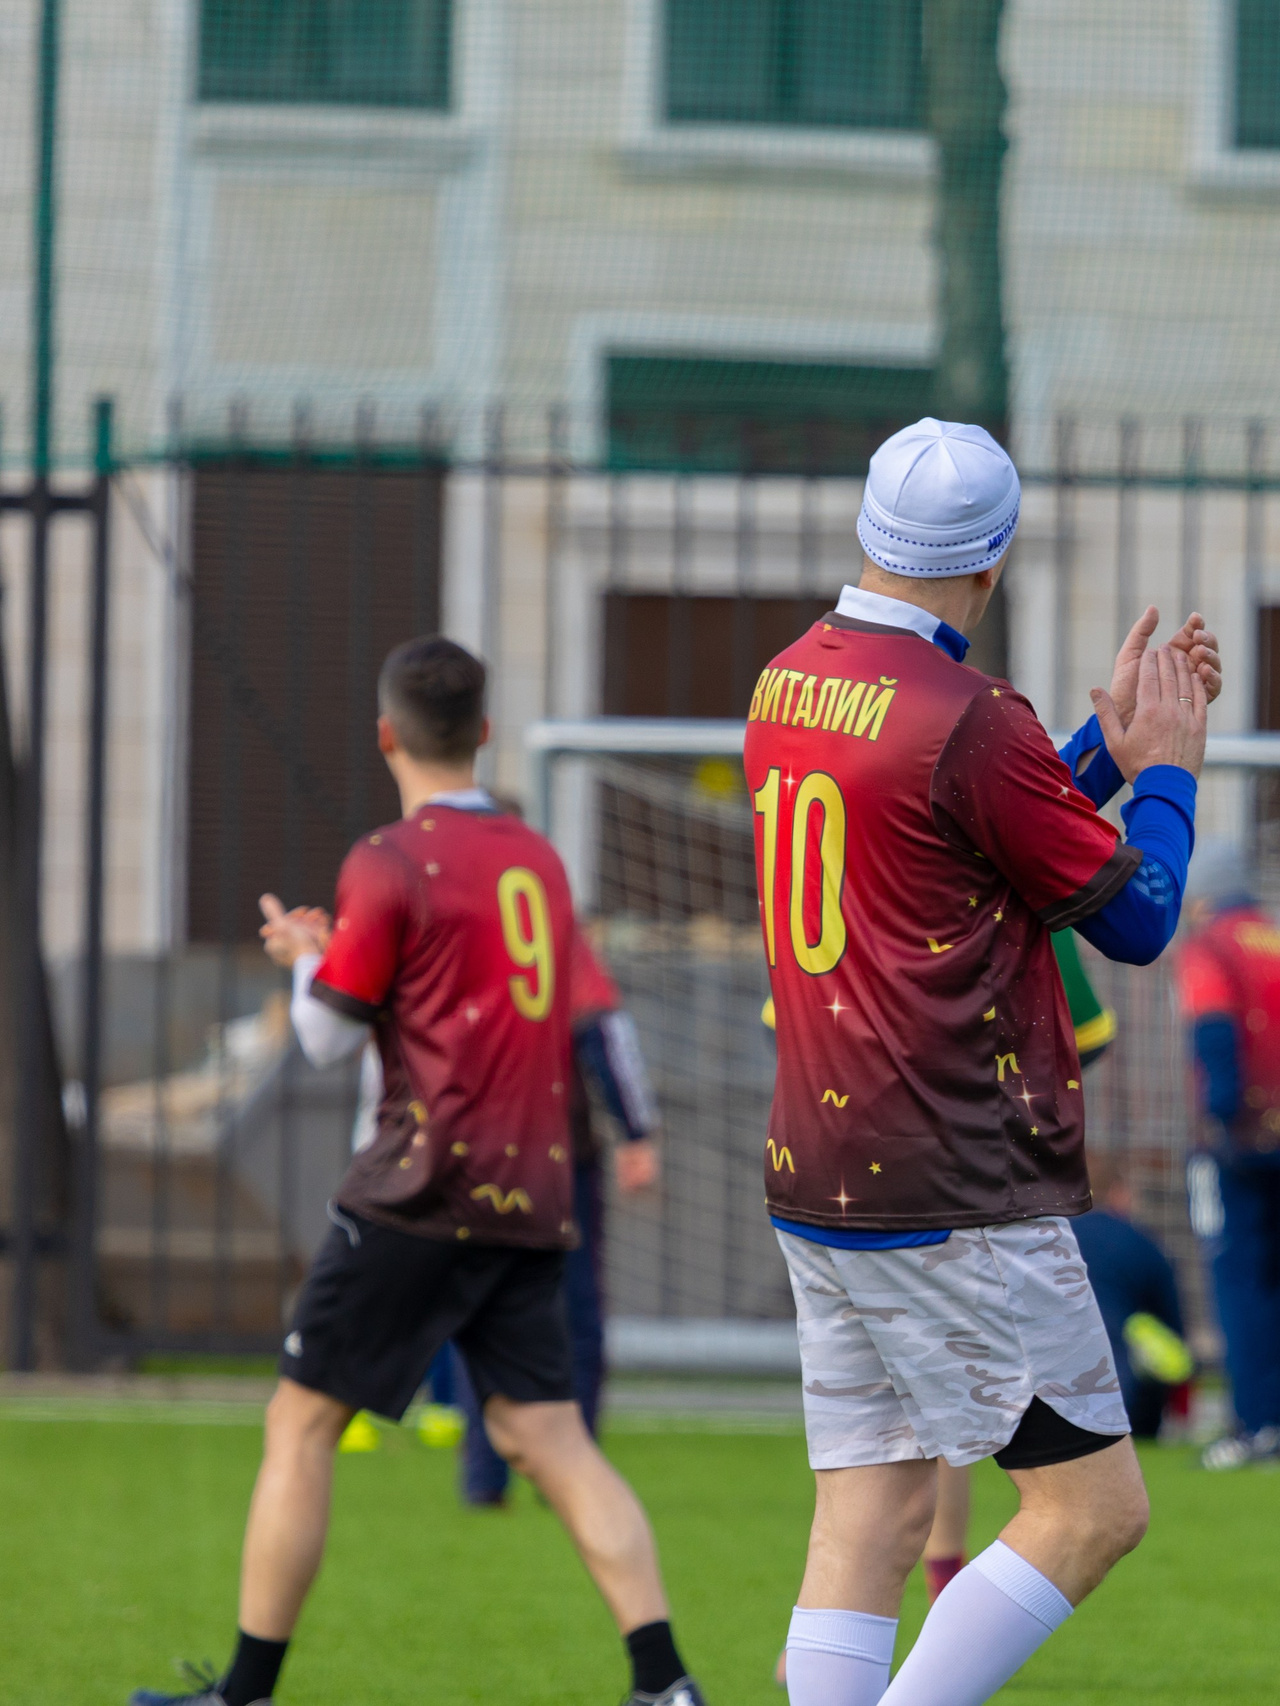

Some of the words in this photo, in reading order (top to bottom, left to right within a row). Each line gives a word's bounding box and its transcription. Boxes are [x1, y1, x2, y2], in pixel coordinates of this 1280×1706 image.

[749, 668, 898, 741] ВИТАЛИЙ
[498, 866, 555, 1022] 9
[754, 765, 847, 977] 10
